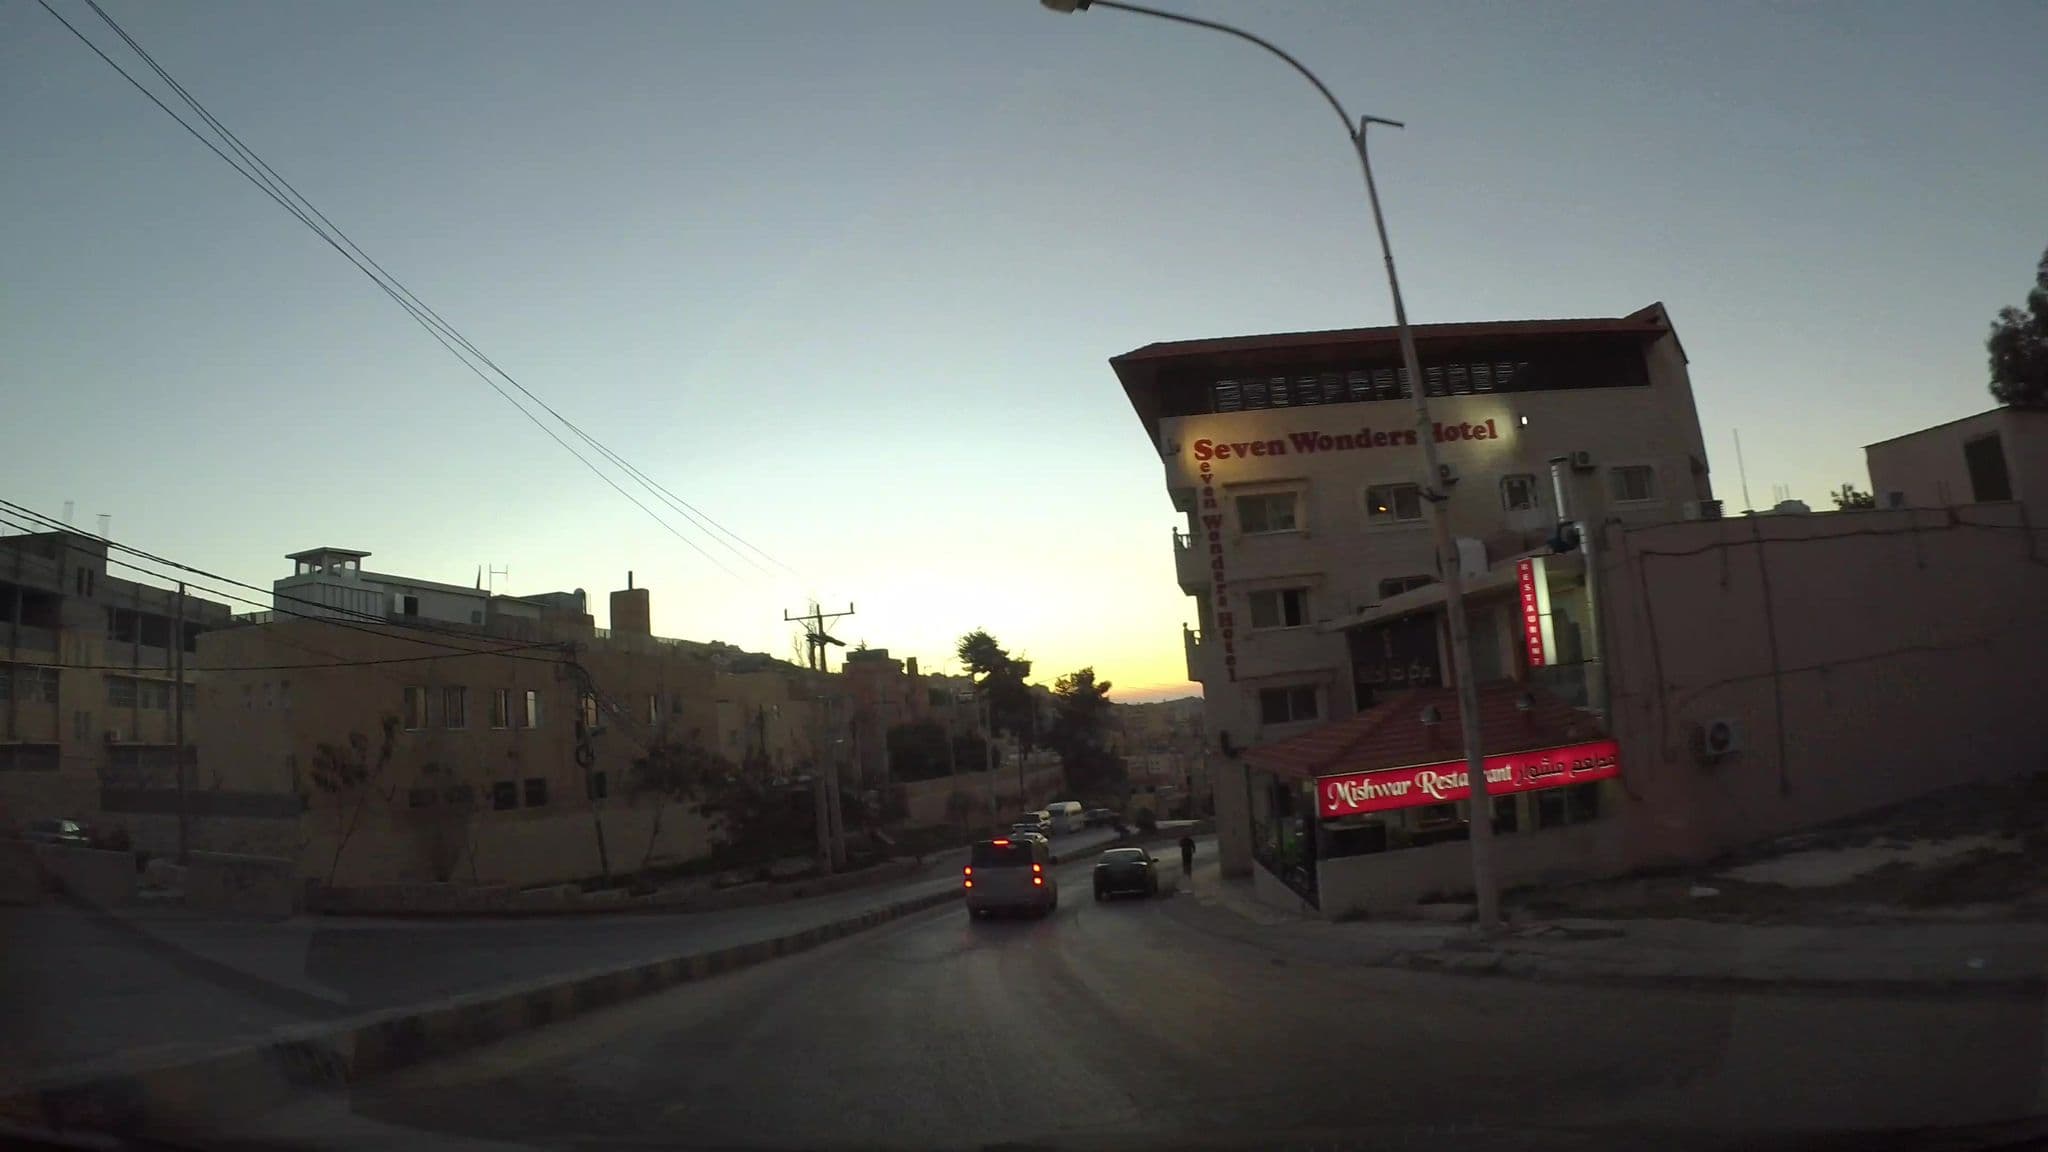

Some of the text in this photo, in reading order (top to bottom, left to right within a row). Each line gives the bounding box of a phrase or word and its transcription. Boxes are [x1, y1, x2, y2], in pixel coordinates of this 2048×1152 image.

[1193, 438, 1286, 461] Seven
[1288, 427, 1417, 454] Wonders
[1521, 563, 1541, 666] RESTAURANT
[1327, 777, 1412, 810] Mishwar
